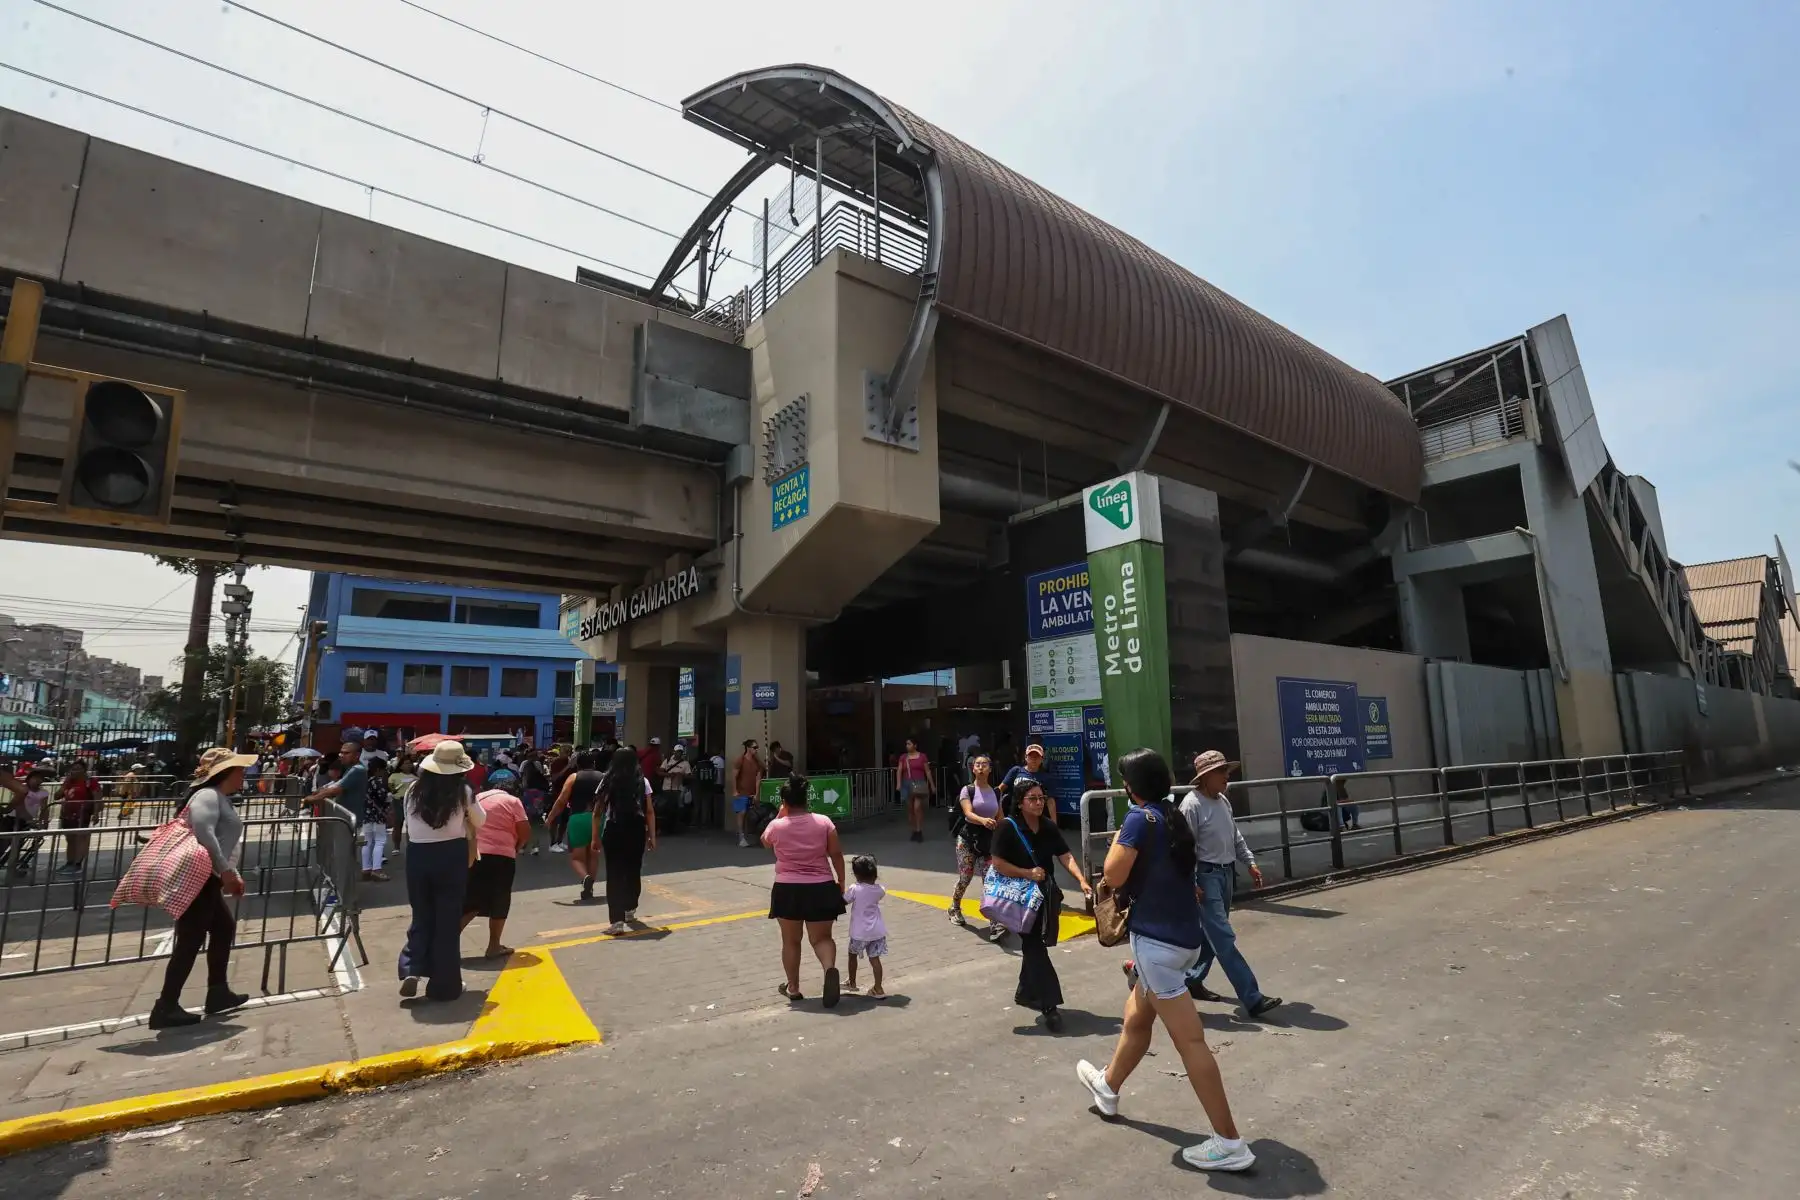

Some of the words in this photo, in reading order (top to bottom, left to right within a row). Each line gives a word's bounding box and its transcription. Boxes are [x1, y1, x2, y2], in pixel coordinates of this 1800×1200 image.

[776, 476, 798, 497] VENTA
[800, 472, 805, 484] Y
[774, 487, 807, 513] RECARGA
[1119, 503, 1130, 524] 1
[1039, 572, 1089, 596] PROHIB
[1120, 561, 1139, 630] Lima
[580, 597, 627, 640] ESTACION
[630, 566, 699, 619] GAMARRA
[1040, 598, 1059, 615] LA
[1064, 590, 1093, 611] VEN
[1104, 594, 1122, 675] Metro
[1124, 637, 1142, 673] de
[1305, 689, 1311, 698] EL
[1312, 690, 1337, 699] COMERCIO
[1305, 702, 1340, 712] AMBULATORIO
[1088, 717, 1098, 726] NO
[1308, 726, 1316, 735] EN
[1316, 726, 1327, 735] ESTA
[1328, 726, 1341, 735] ZONA
[1089, 731, 1097, 739] EL
[1098, 730, 1106, 738] IN
[1090, 741, 1107, 749] PIRO
